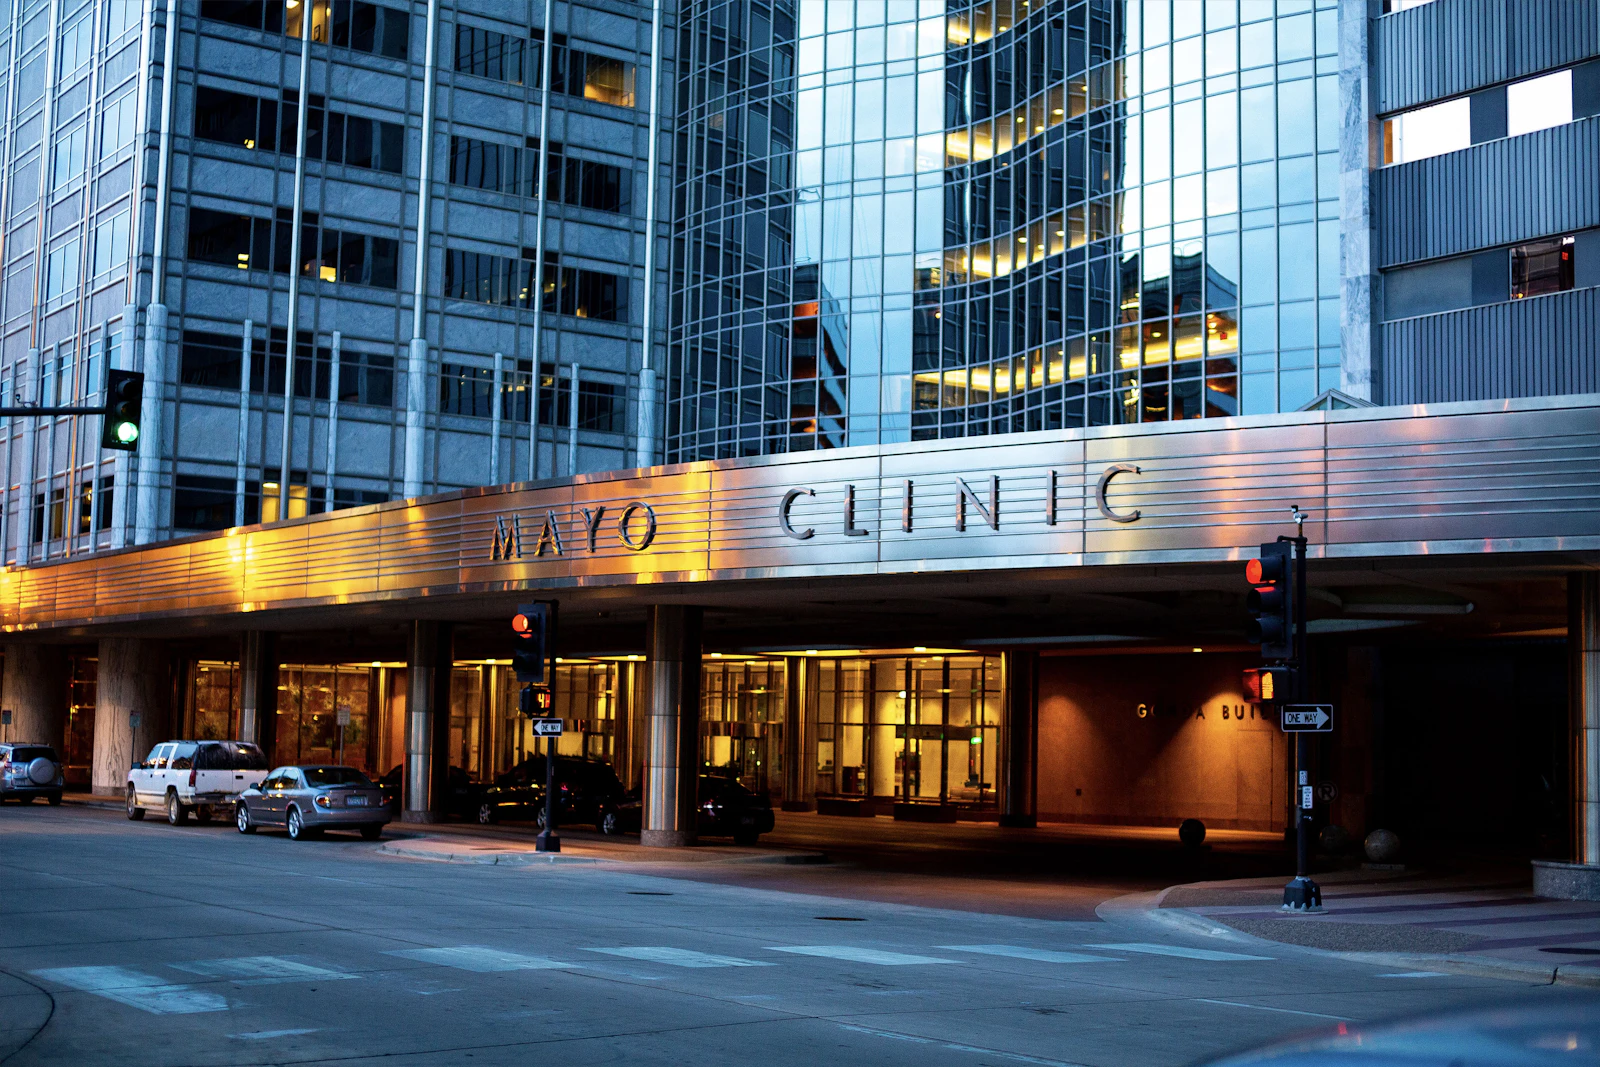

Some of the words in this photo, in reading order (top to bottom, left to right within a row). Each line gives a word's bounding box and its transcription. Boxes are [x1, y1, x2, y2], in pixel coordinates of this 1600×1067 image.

[489, 501, 657, 561] MAYO
[778, 463, 1142, 541] CLINIC
[1287, 713, 1301, 723] ONE
[1303, 713, 1318, 723] WAY
